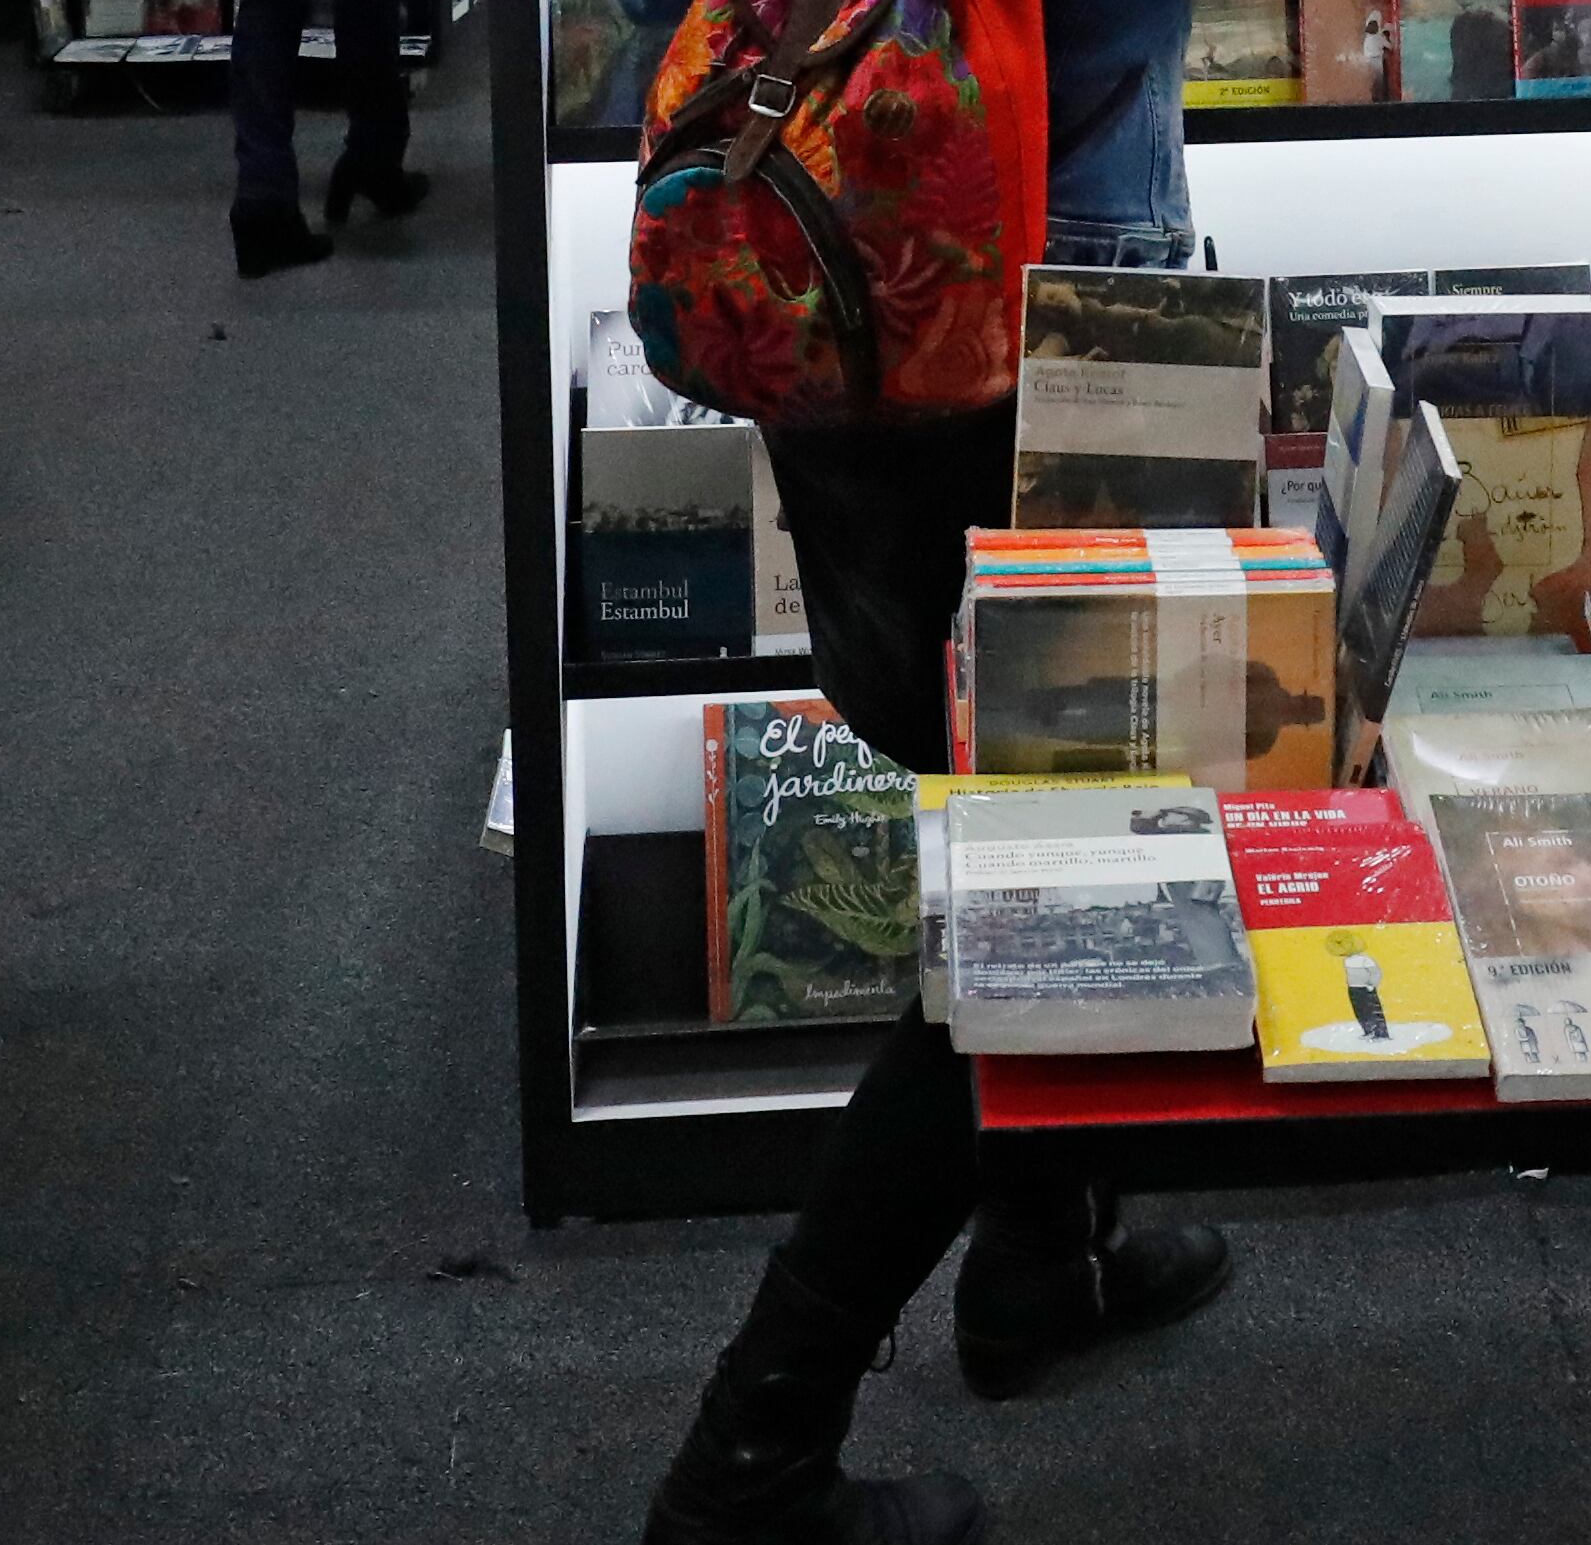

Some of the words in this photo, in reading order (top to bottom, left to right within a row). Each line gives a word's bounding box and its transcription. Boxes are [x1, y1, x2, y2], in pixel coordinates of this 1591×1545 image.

[1452, 283, 1503, 296] Siempre
[1289, 292, 1304, 307] Y
[1306, 290, 1345, 307] todo
[1289, 311, 1312, 322] Una
[1315, 310, 1358, 322] comedia
[1033, 382, 1068, 396] Claus
[1073, 385, 1081, 397] y
[1085, 385, 1124, 395] Lucas
[1281, 480, 1305, 495] ¿Por
[774, 574, 801, 592] La
[600, 599, 690, 622] Estambul
[774, 596, 803, 615] de
[760, 718, 806, 756] El
[763, 768, 916, 825] jardinero
[1225, 812, 1246, 821] UN
[1249, 808, 1271, 821] DÍA
[1275, 810, 1291, 820] EN
[1295, 810, 1312, 820] LA
[1315, 810, 1346, 819] VIDA
[1503, 837, 1527, 848] Ali
[1530, 836, 1572, 848] Smith
[1257, 883, 1275, 894] EL
[1278, 880, 1321, 894] AGRIO
[1515, 871, 1575, 889] OTOÑO
[804, 981, 895, 1003] Impedimenta
